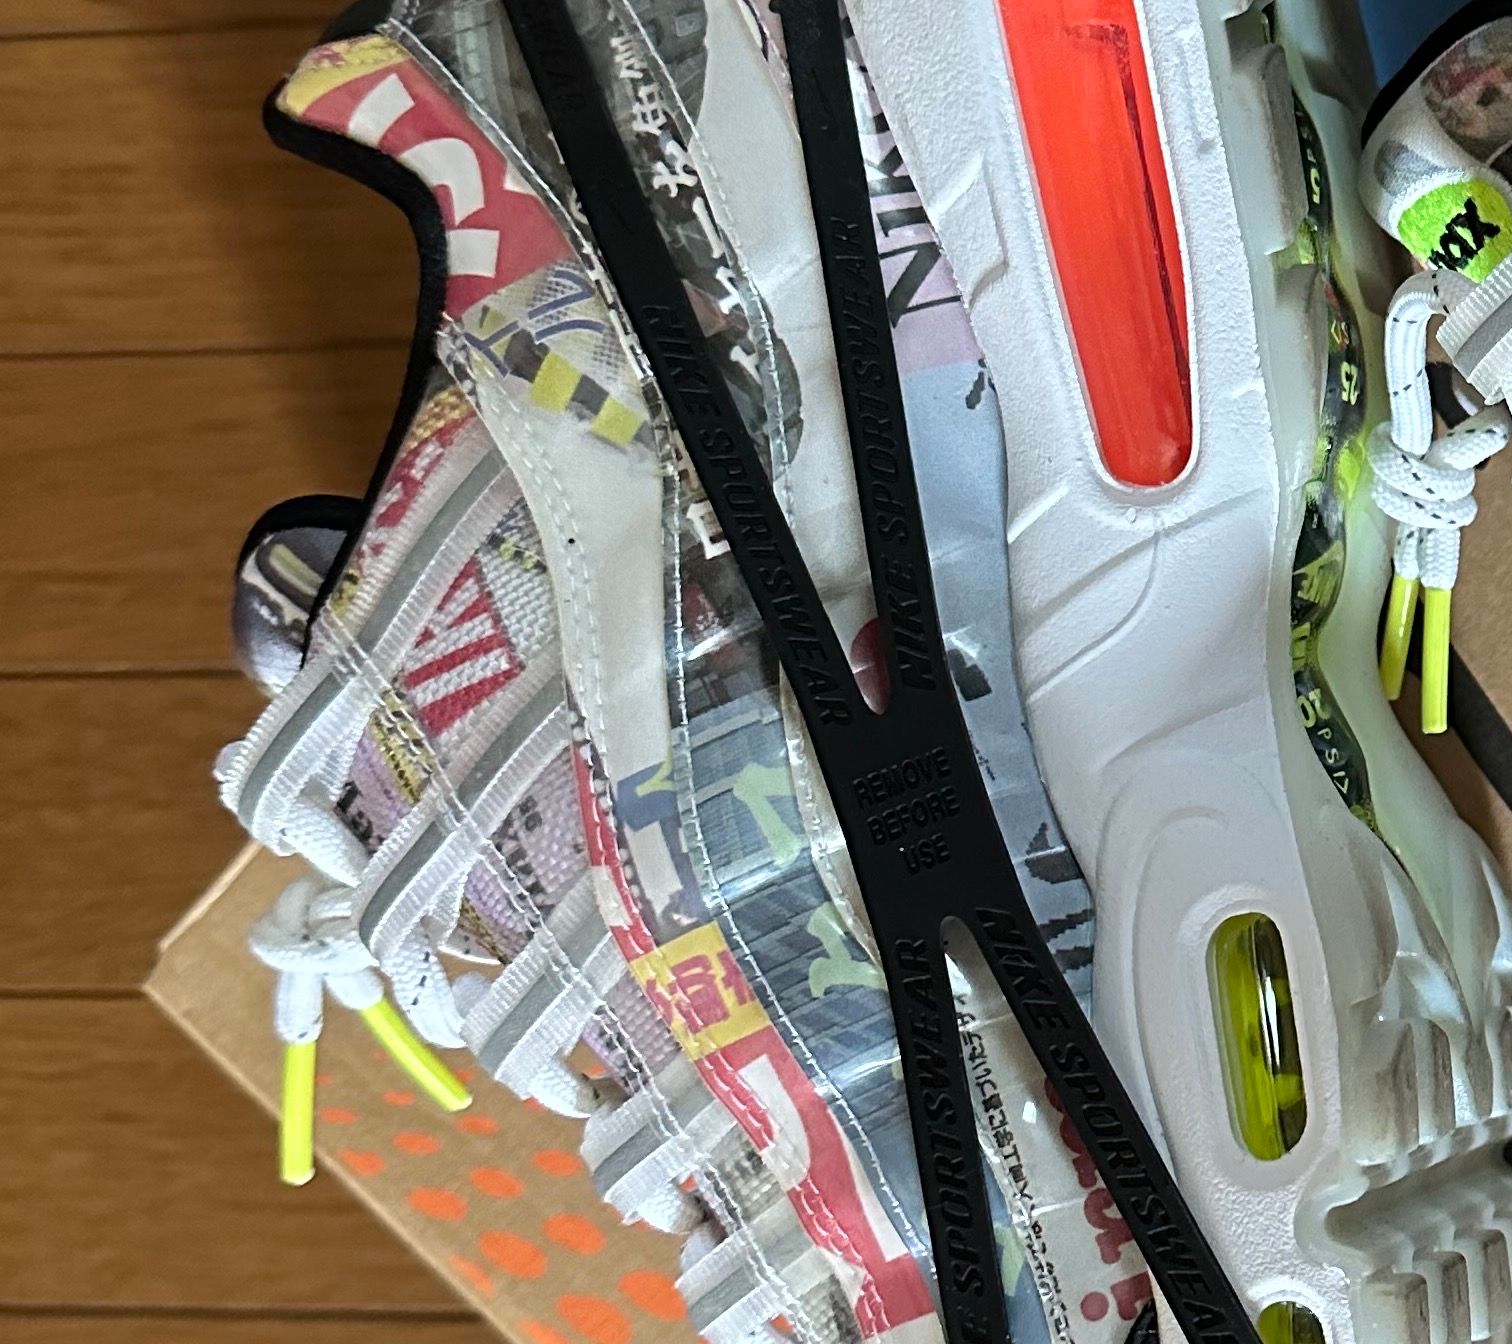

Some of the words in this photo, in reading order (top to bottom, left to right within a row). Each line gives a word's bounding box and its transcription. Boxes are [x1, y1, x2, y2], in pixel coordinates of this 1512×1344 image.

[830, 214, 910, 546] SPORTSWEAR
[640, 304, 724, 420] NIKE
[702, 426, 853, 726] SPORTSWEAR
[886, 556, 938, 691] NIKE
[852, 746, 951, 810] REMOVE
[866, 785, 961, 846] BEFORE
[902, 832, 950, 875] USE
[974, 906, 1072, 1035] NIKE
[893, 934, 986, 1300] SPORTSWEAR
